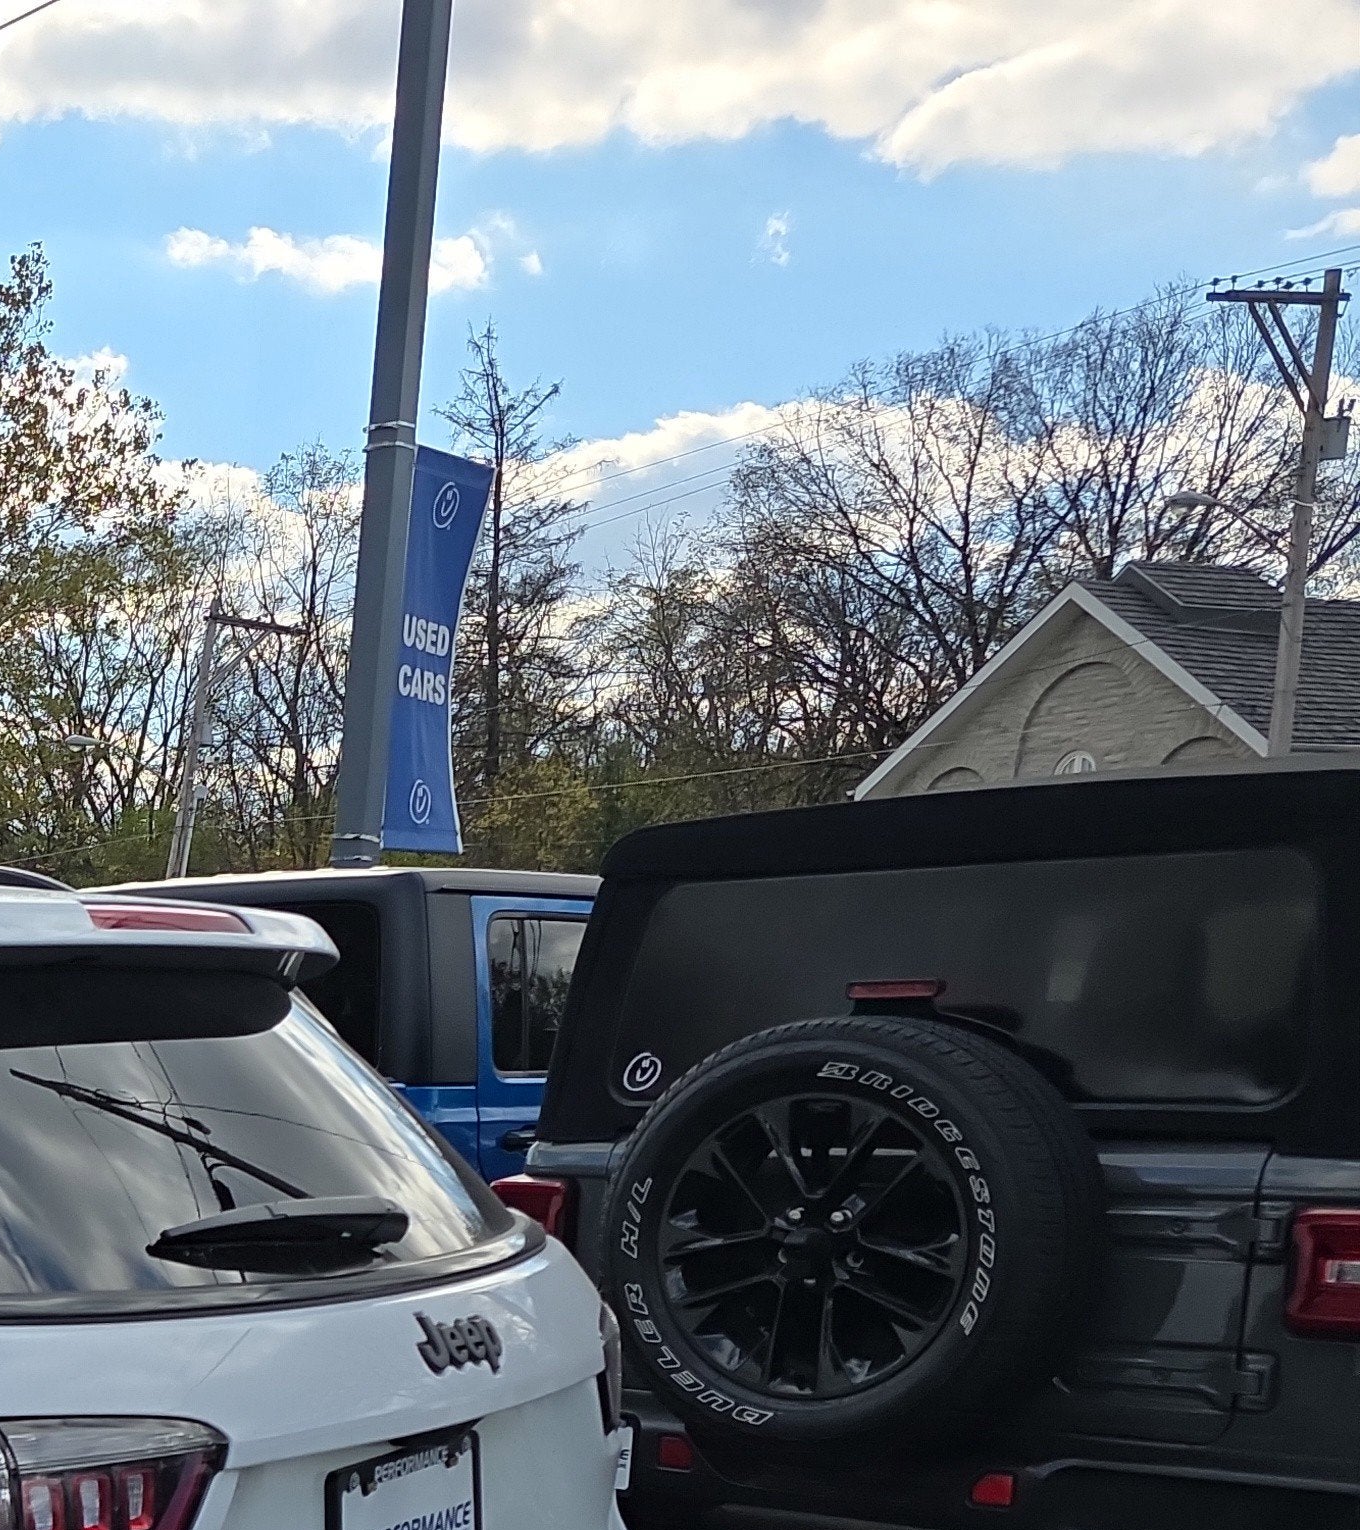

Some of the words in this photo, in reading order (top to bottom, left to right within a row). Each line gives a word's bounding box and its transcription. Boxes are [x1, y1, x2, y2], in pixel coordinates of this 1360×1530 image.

[403, 613, 451, 657] USED
[398, 664, 446, 706] CARS
[816, 1060, 997, 1336] BRIDGESTONE
[411, 1310, 504, 1376] Jeep
[623, 1282, 775, 1426] DUELER
